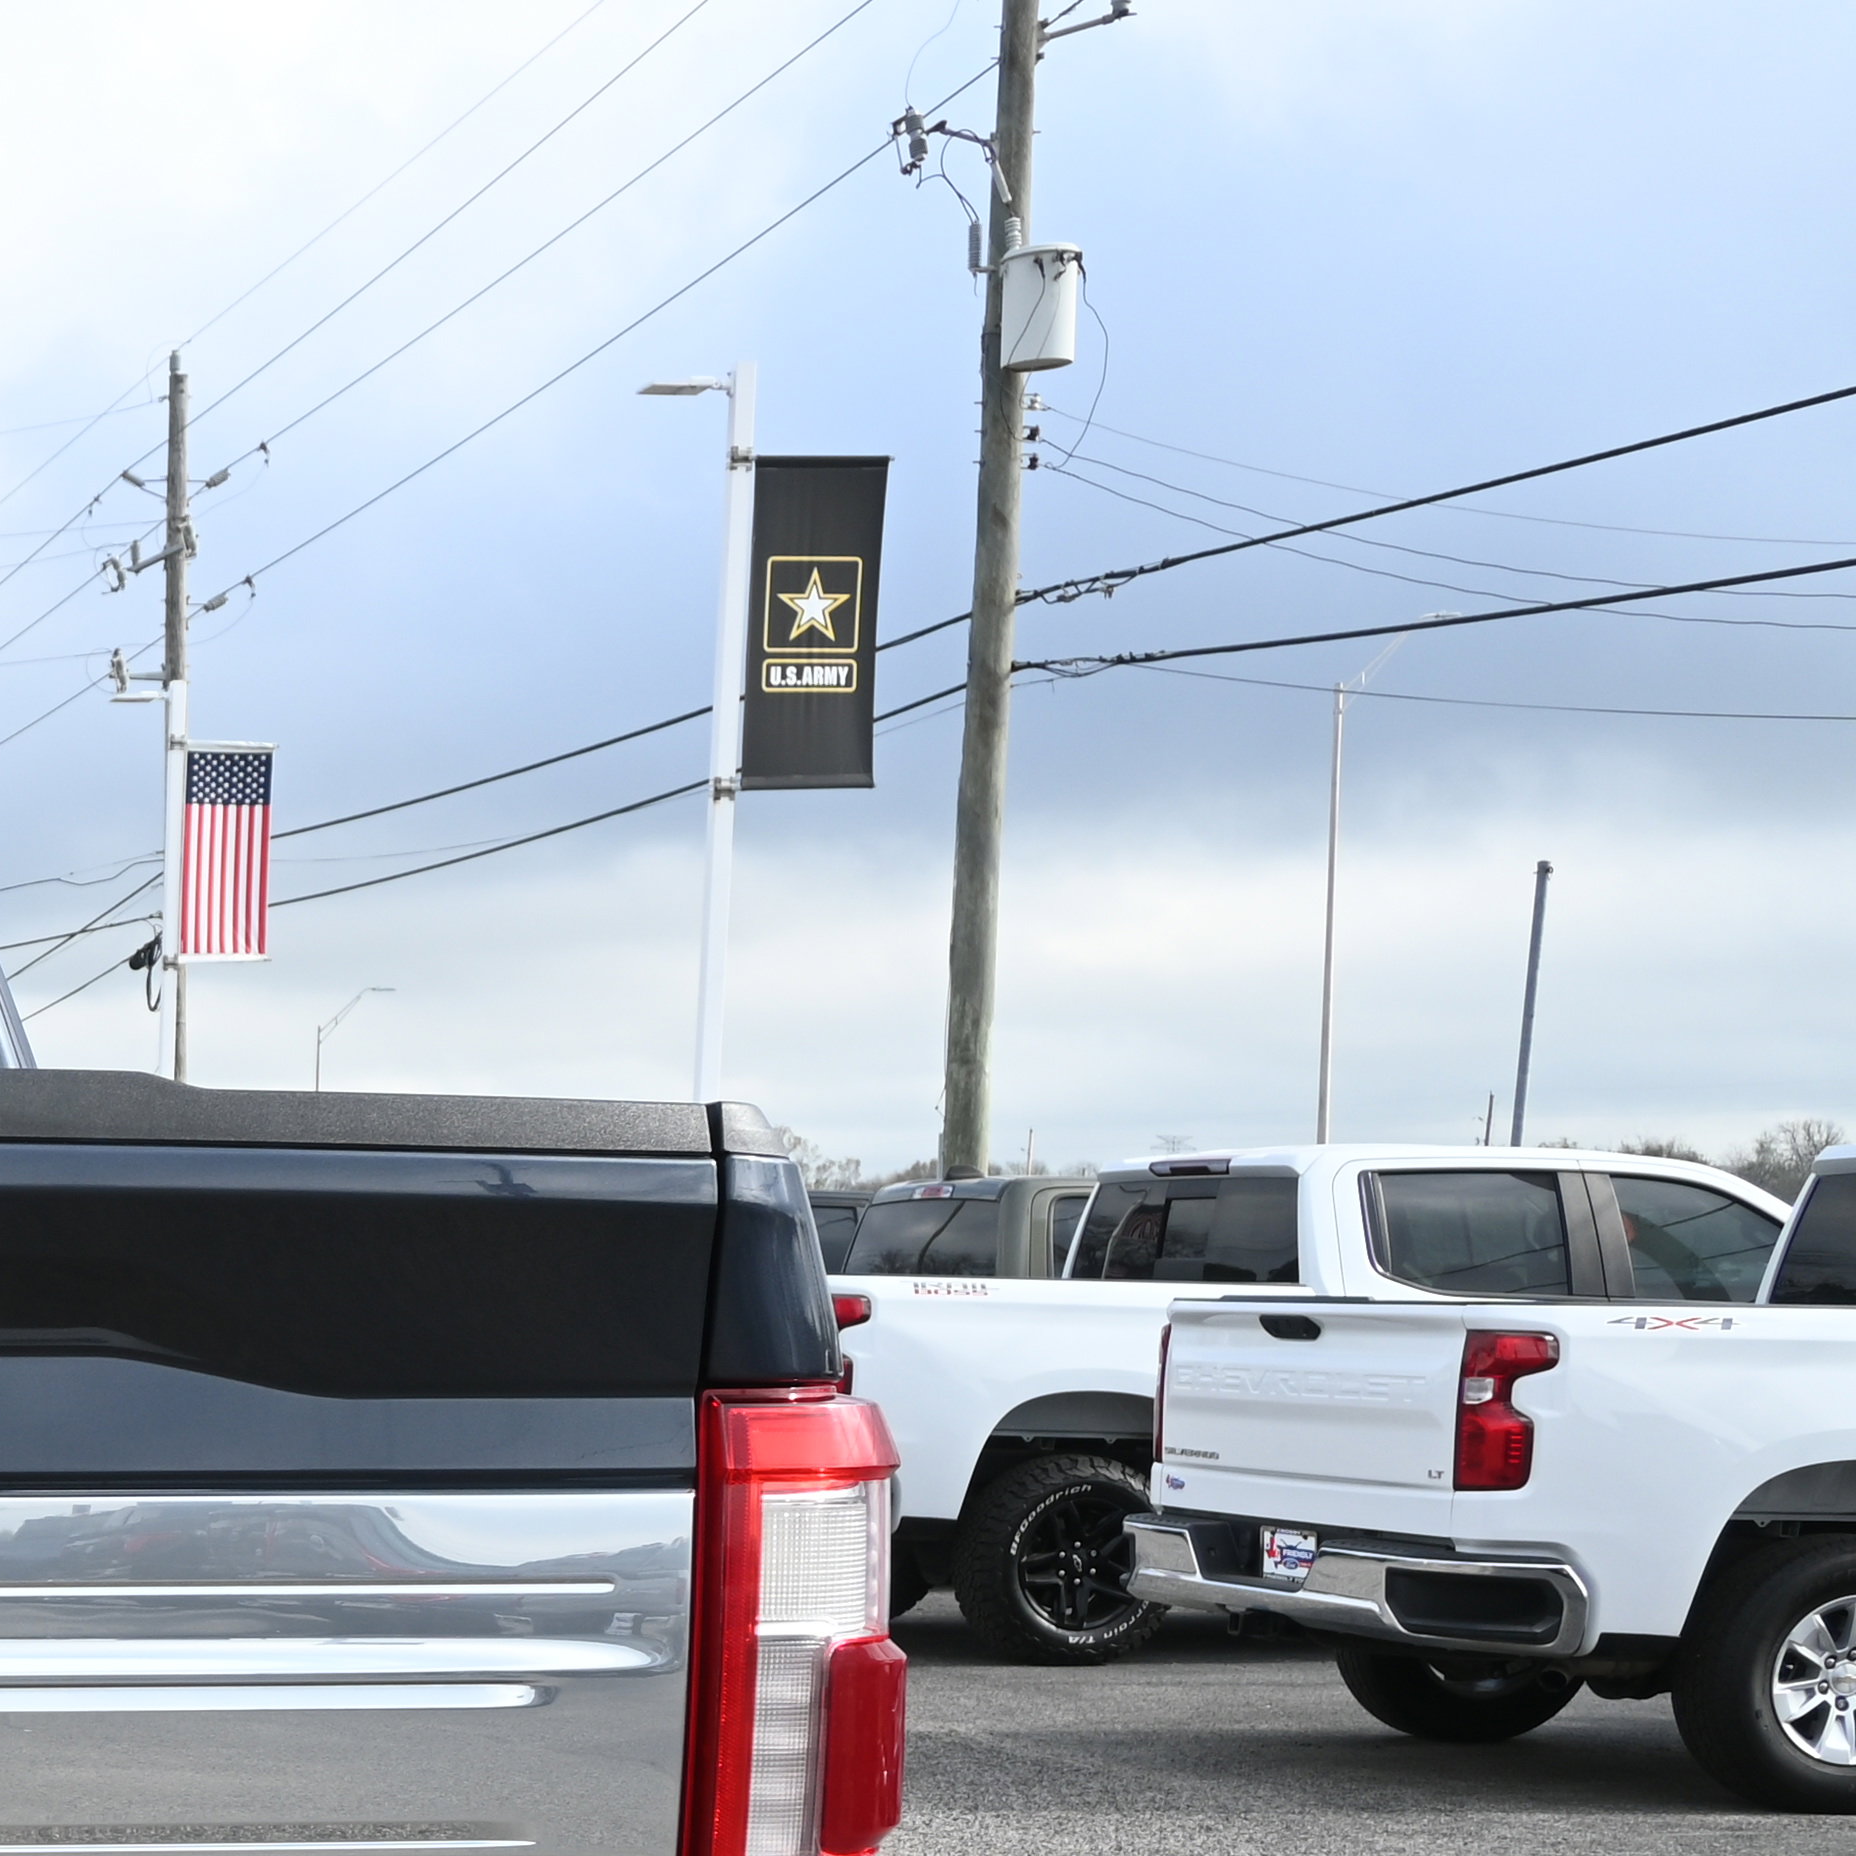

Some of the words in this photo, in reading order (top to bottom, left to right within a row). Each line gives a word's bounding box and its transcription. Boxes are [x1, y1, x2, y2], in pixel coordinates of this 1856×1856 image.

[1173, 1364, 1427, 1403] CHEVROLET
[1428, 1469, 1444, 1480] LT
[1009, 1484, 1092, 1557] BFGoodrich
